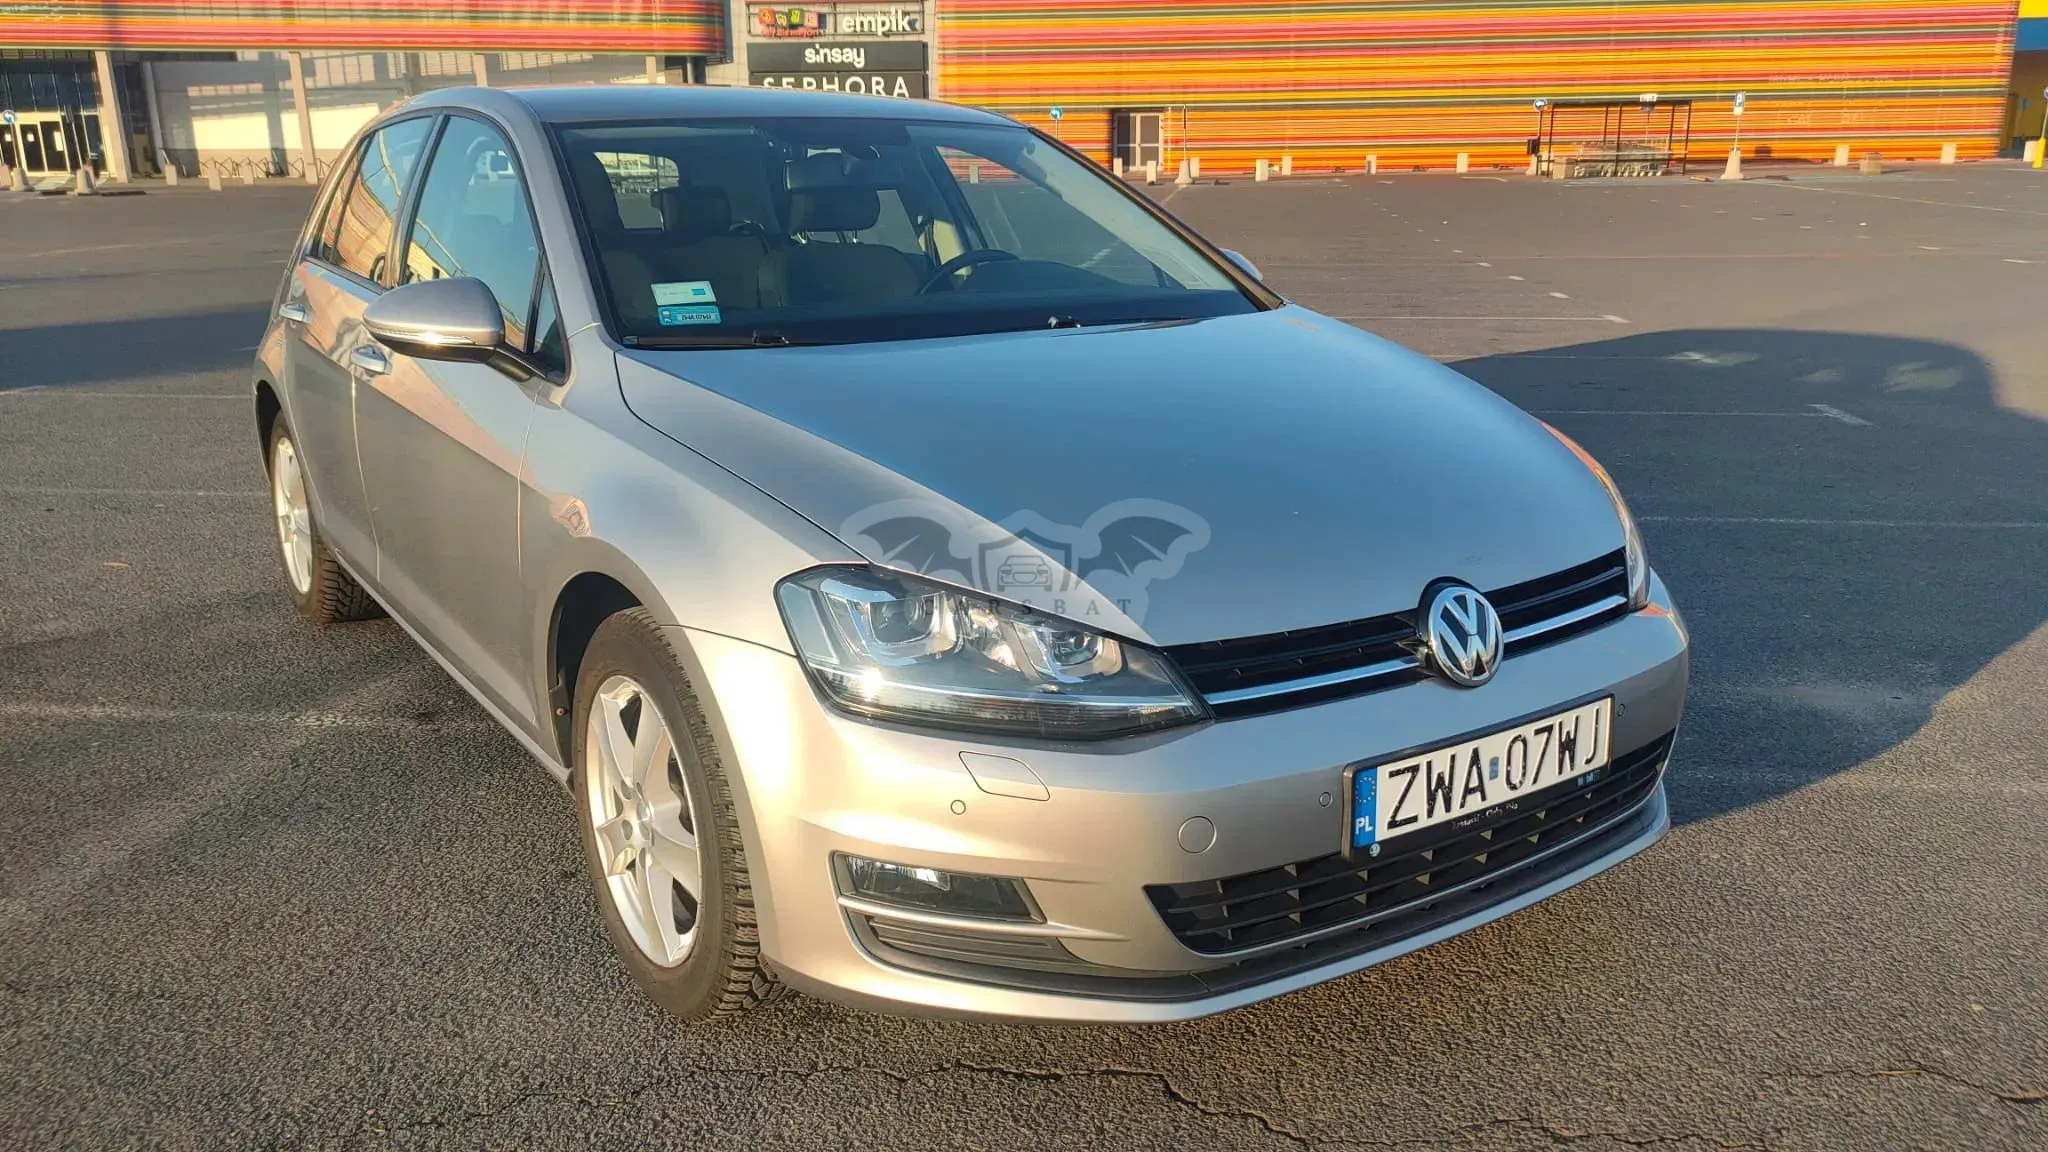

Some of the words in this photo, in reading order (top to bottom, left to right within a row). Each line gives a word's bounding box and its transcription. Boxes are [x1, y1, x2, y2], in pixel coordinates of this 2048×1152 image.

[842, 9, 910, 36] empik
[804, 43, 865, 67] sinsay
[1386, 746, 1487, 830] ZWA
[1504, 708, 1600, 791] 07WJ
[1355, 817, 1374, 835] PL
